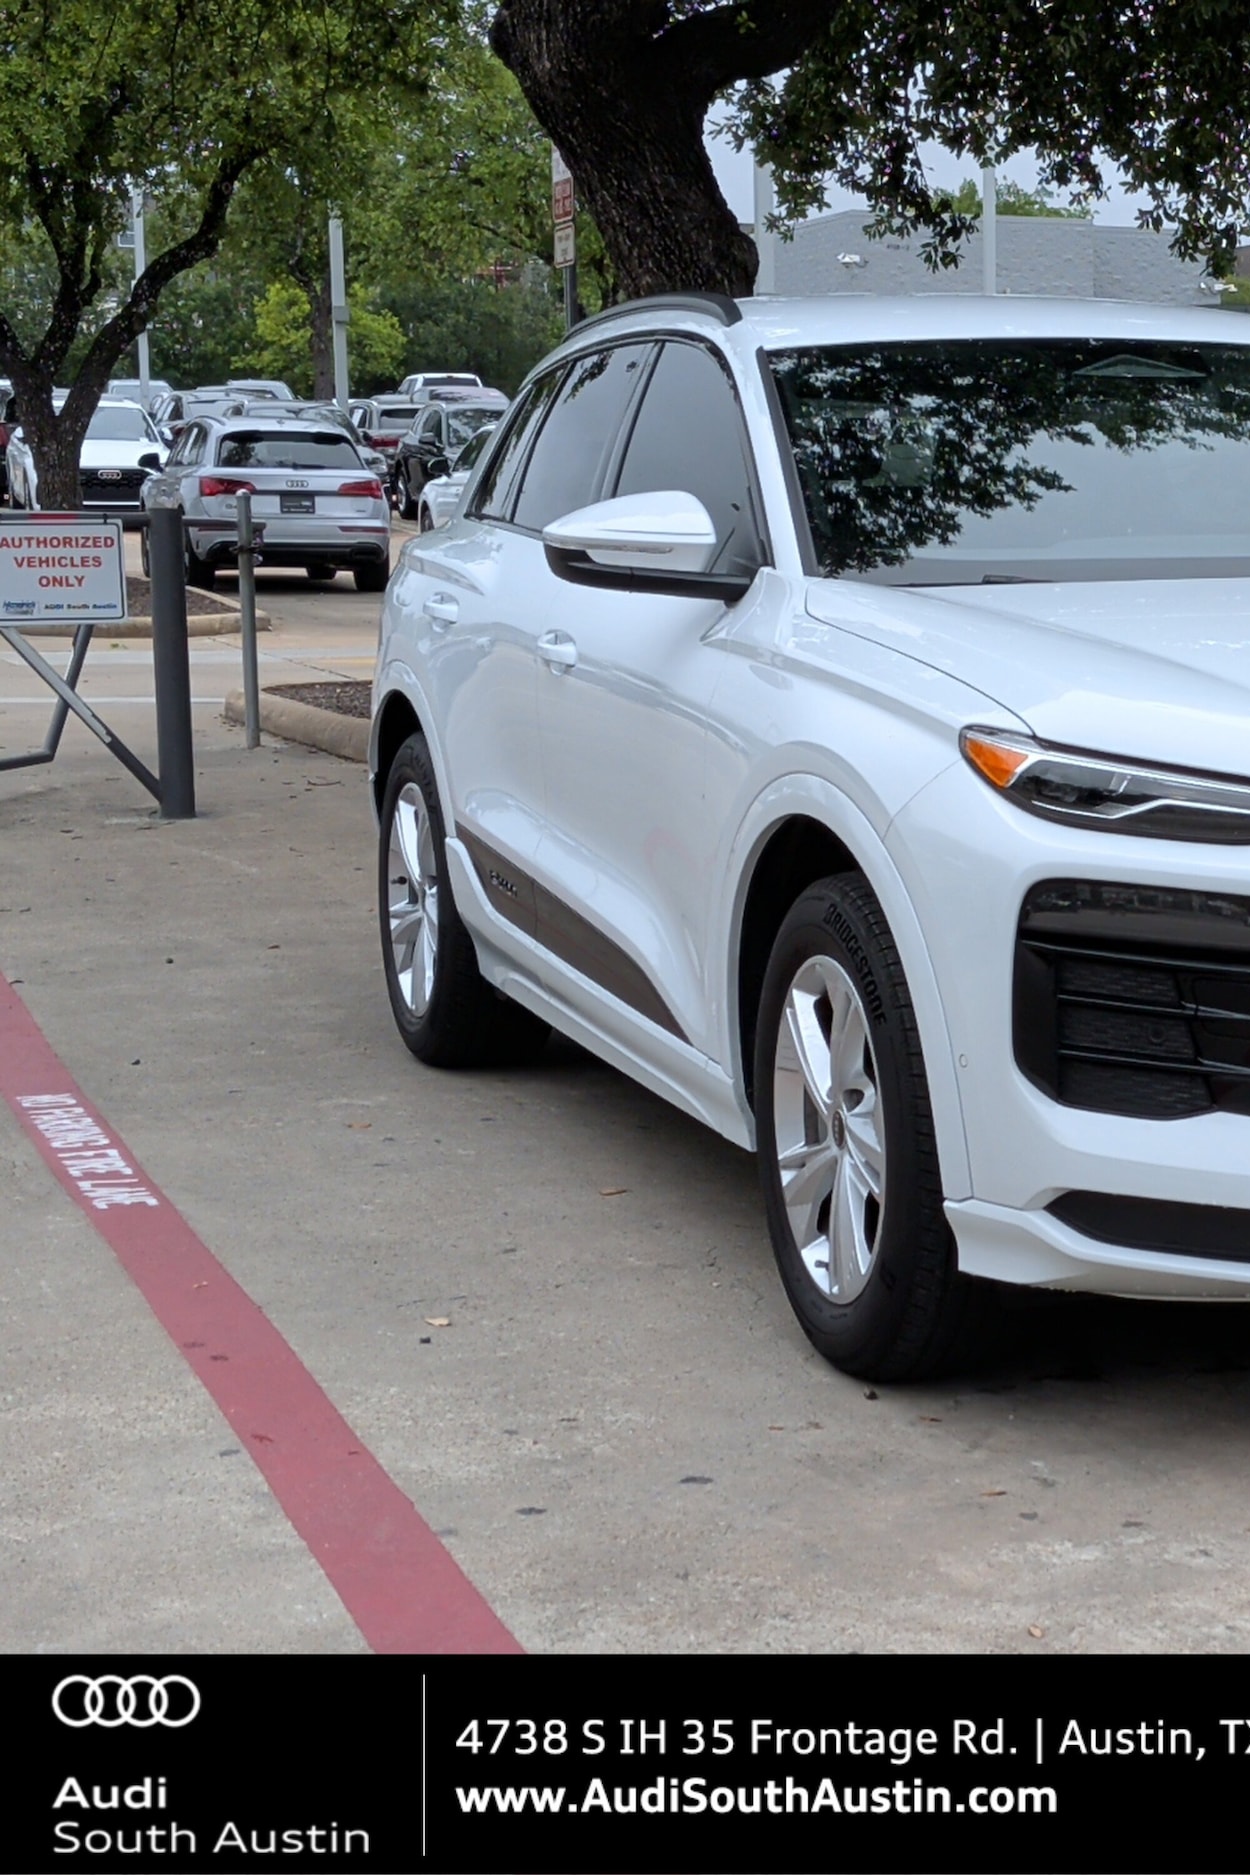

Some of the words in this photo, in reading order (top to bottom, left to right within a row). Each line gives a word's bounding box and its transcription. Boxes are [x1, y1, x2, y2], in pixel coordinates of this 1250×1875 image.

[0, 536, 115, 549] AUTHORIZED
[13, 556, 103, 568] VEHICLES
[38, 575, 86, 588] ONLY
[822, 902, 888, 1027] BRIDGESTONE
[57, 1149, 134, 1177] FIRE
[76, 1178, 160, 1209] LANE
